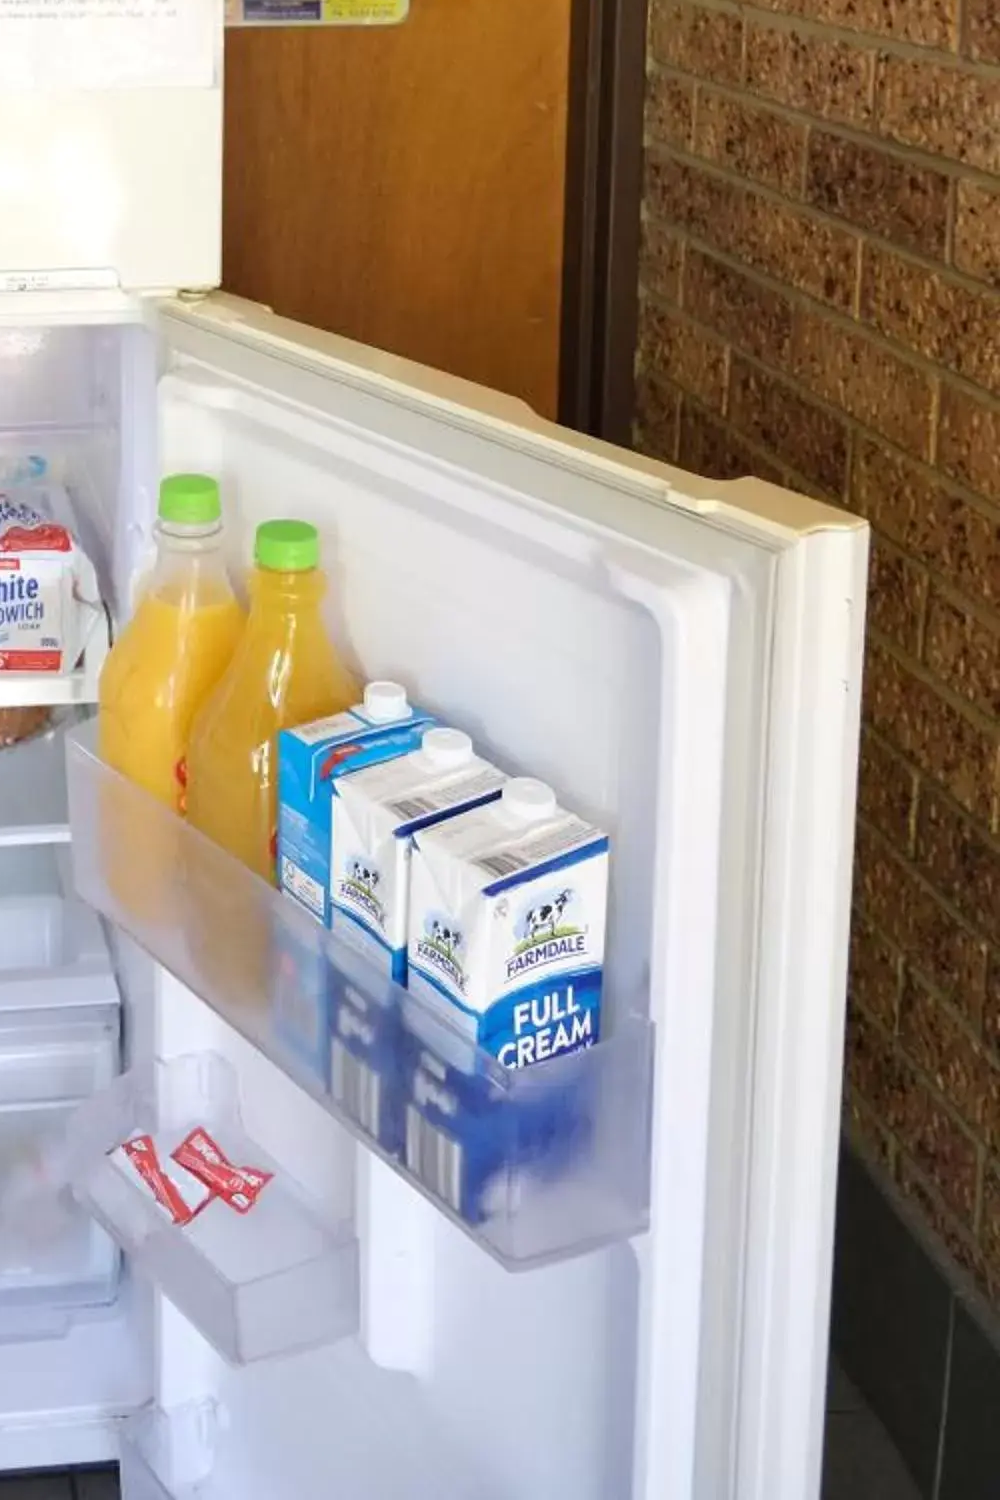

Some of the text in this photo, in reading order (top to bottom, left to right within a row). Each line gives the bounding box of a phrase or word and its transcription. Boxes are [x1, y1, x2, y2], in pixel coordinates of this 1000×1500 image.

[507, 935, 585, 977] FARMDALE
[514, 986, 580, 1034] FULL
[498, 1008, 592, 1070] CREAM
